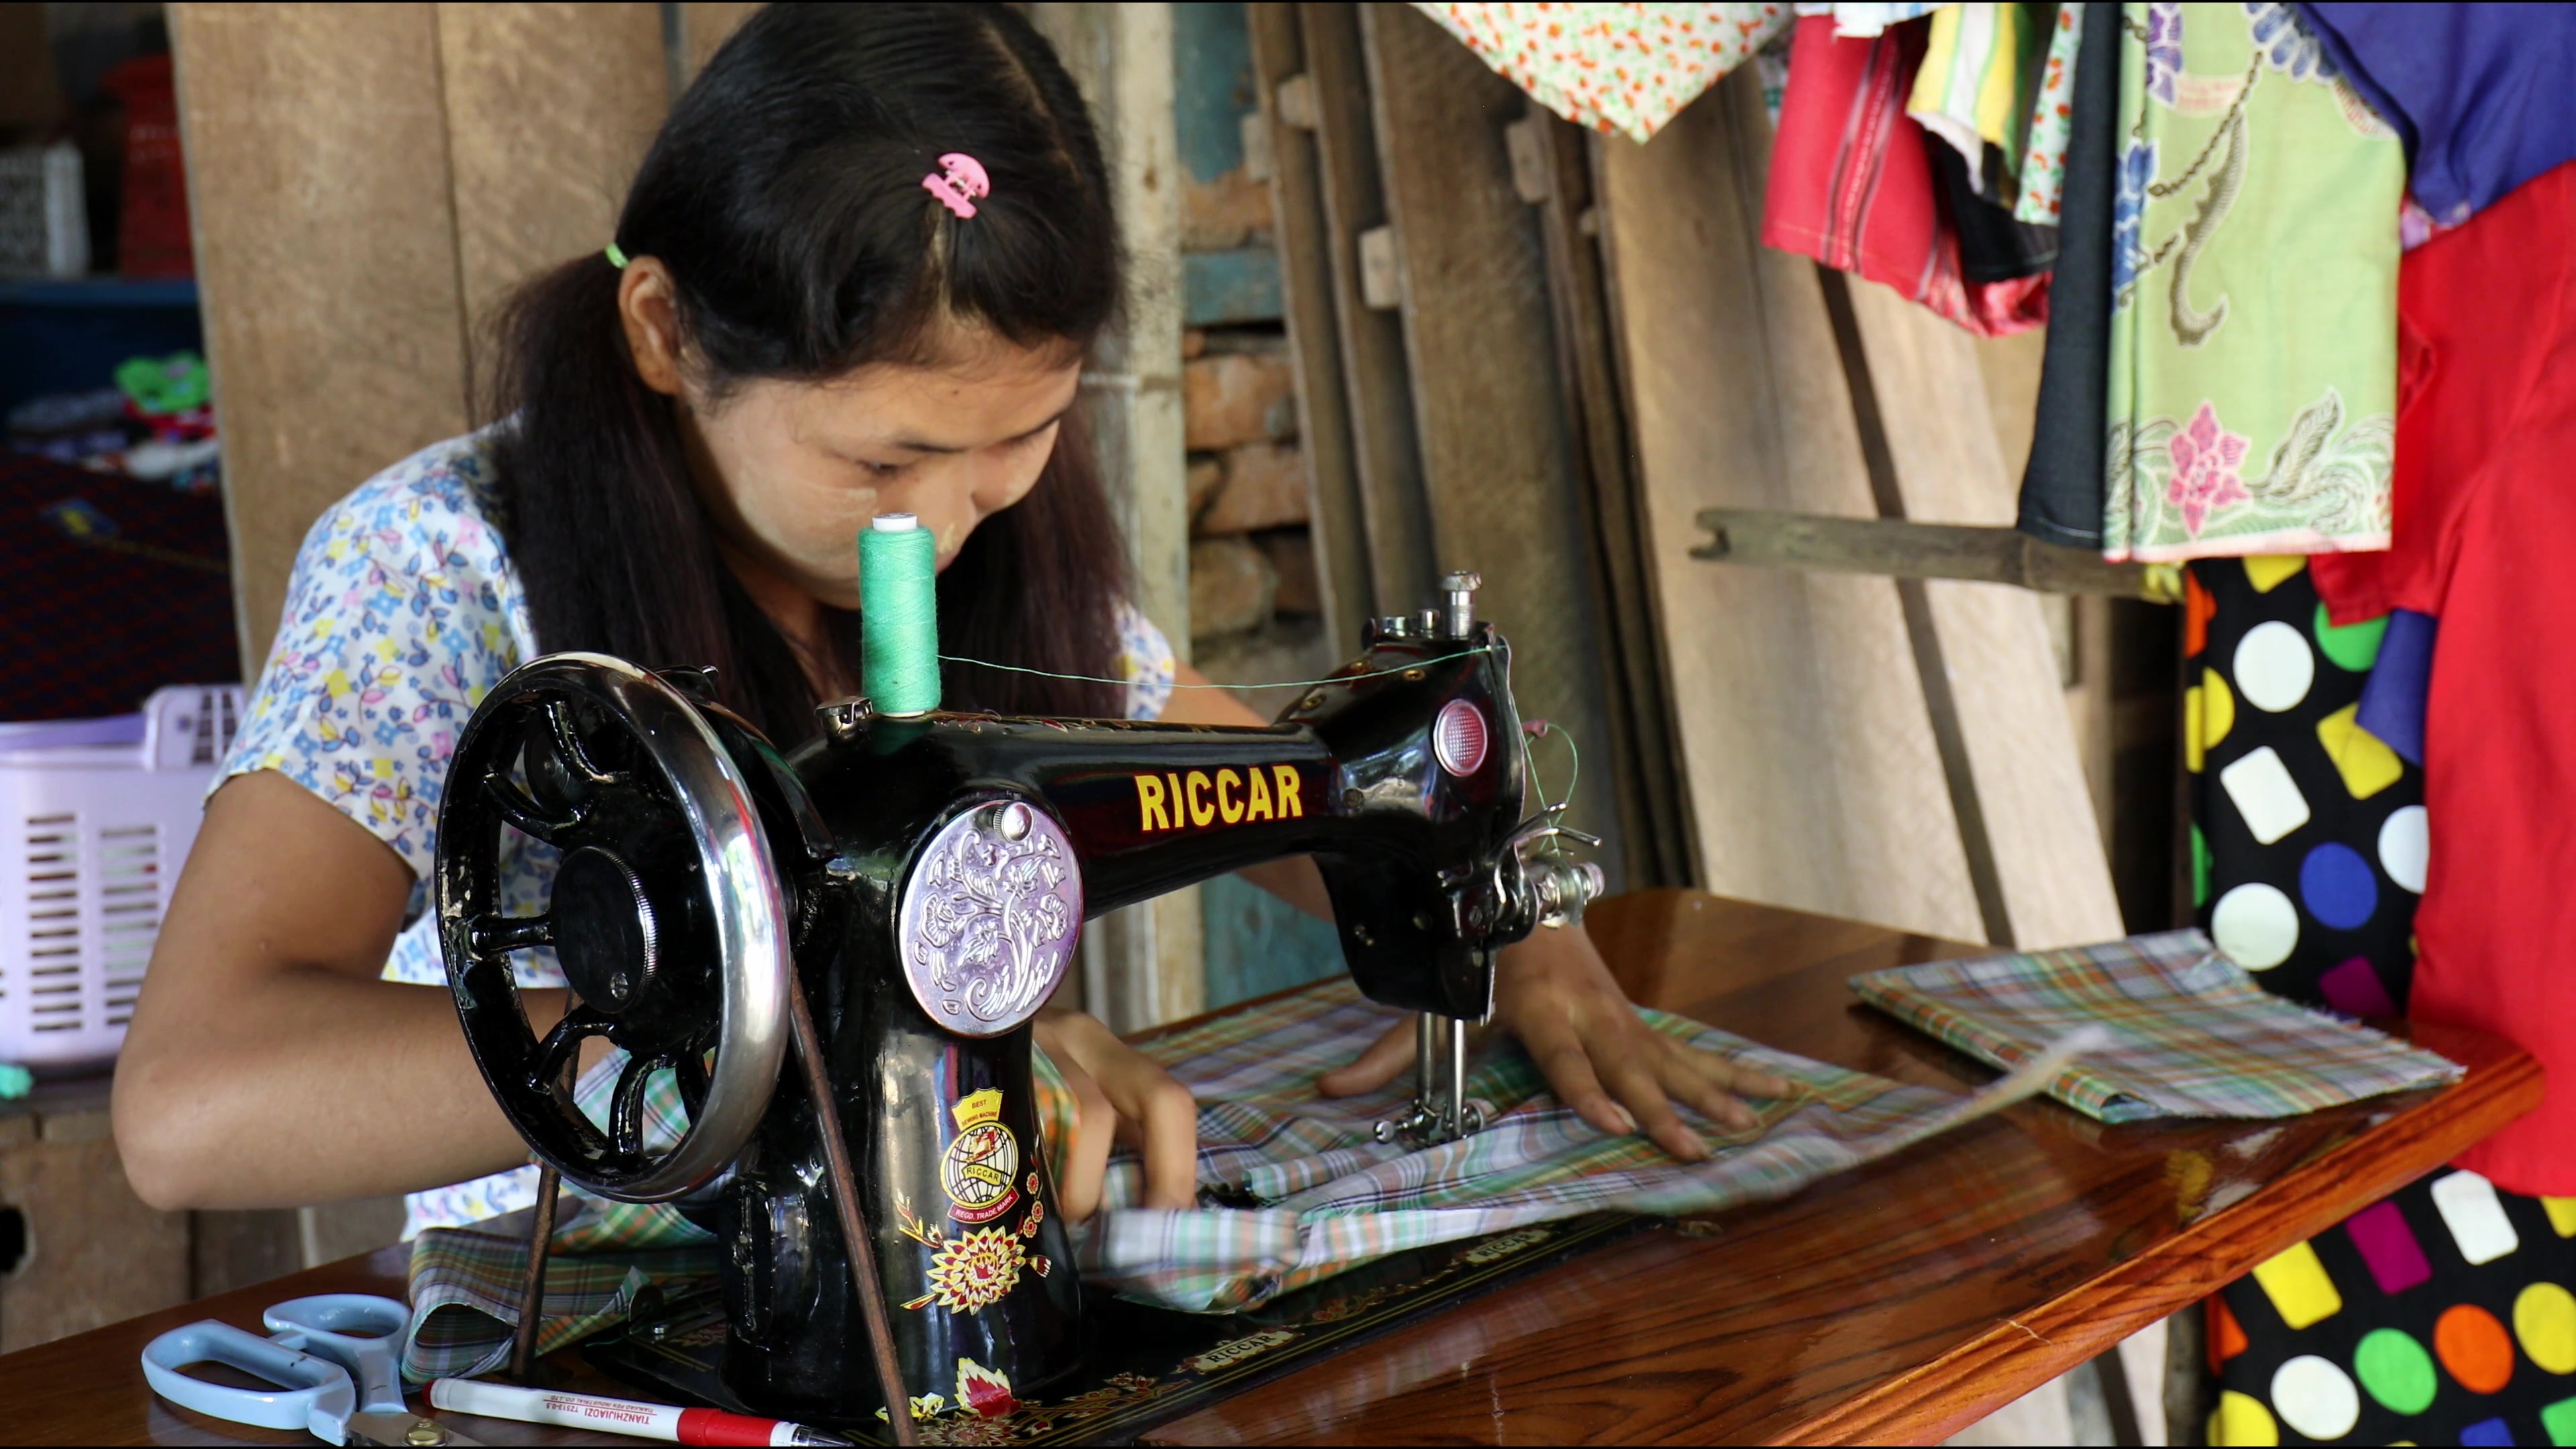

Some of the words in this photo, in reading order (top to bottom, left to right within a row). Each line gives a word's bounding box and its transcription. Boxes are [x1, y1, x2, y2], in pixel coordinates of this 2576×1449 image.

[1134, 765, 1303, 832] RICCAR
[972, 1099, 987, 1109] BEST
[961, 1114, 979, 1127] SEWING
[966, 1167, 999, 1181] RICCAR
[955, 1210, 975, 1220] REGD.
[976, 1209, 997, 1220] TRADE
[996, 1194, 1014, 1212] MARK
[1477, 1234, 1536, 1256] RICCAR
[1206, 1335, 1276, 1362] RICCAR
[577, 1398, 612, 1407] INDUSTRIAL
[584, 1407, 649, 1425] TIANZHIJIAOZI
